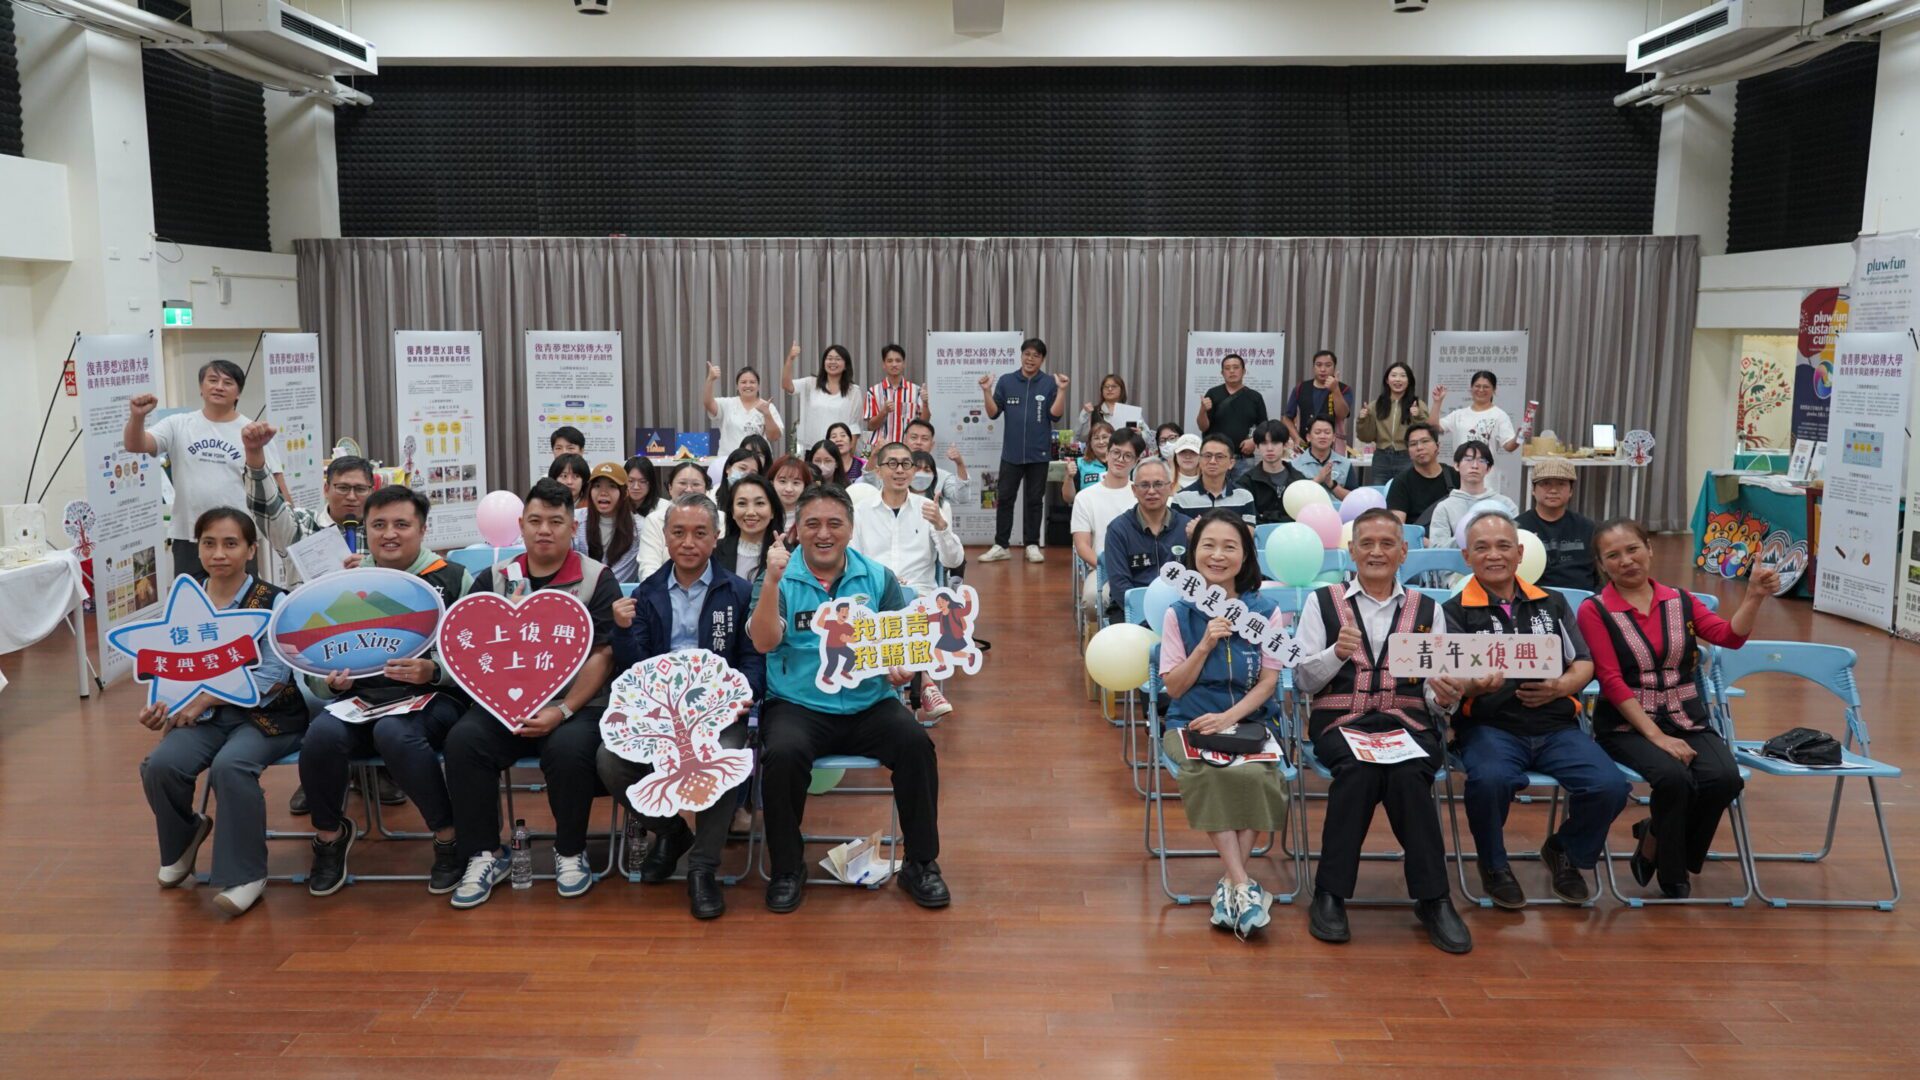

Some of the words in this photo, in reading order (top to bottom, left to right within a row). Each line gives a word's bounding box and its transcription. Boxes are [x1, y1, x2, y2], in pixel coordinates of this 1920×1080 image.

[1866, 256, 1906, 276] pluwfun
[1813, 310, 1848, 326] pluwfun
[86, 357, 149, 377] 復青夢想X銘傳大學
[188, 438, 242, 460] BROOKLYN
[852, 612, 931, 643] 我復青
[1166, 566, 1302, 664] #我是復興青年
[169, 621, 220, 646] 復青
[457, 621, 576, 650] 愛上復興
[712, 610, 726, 651] 簡志偉
[153, 646, 246, 673] 聚興雲集
[323, 640, 349, 663] Fu
[355, 631, 403, 653] Xing
[853, 640, 933, 671] 我驕傲
[478, 650, 555, 675] 愛上你
